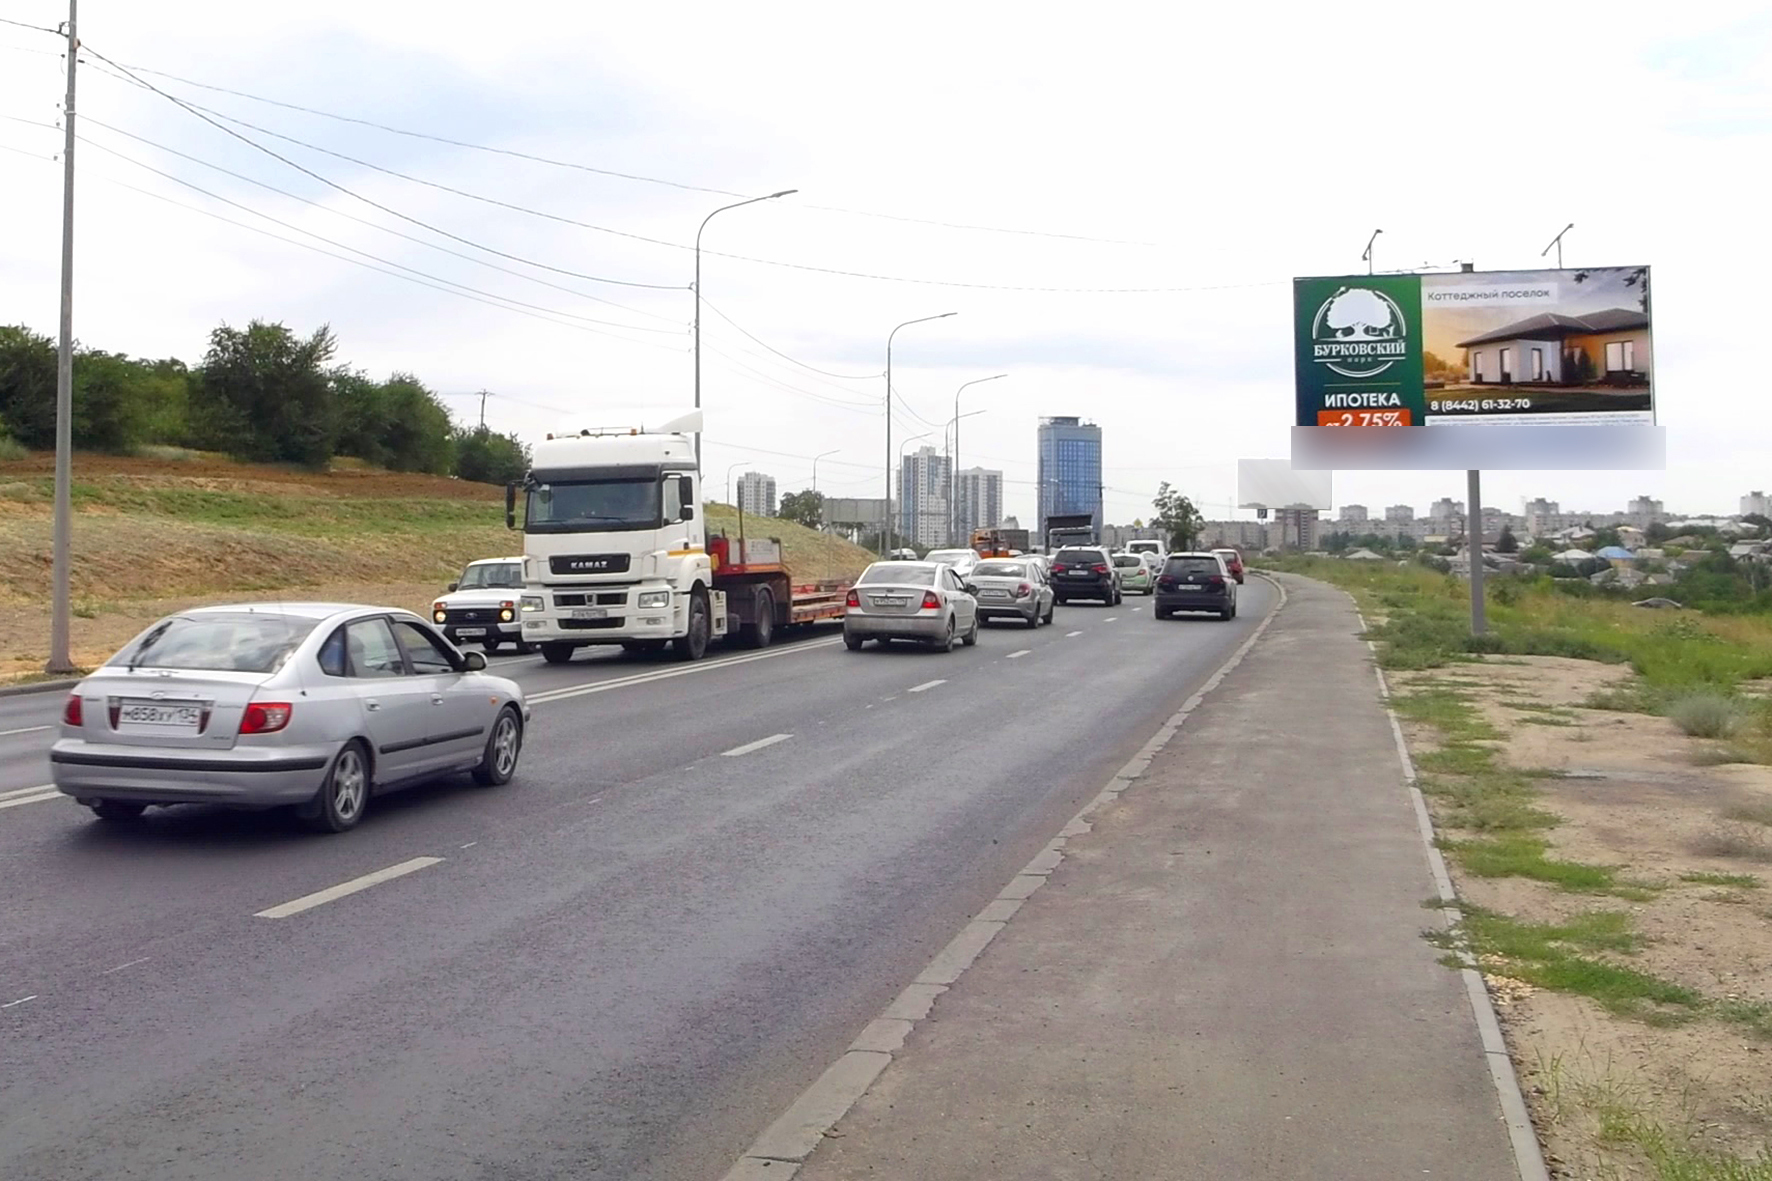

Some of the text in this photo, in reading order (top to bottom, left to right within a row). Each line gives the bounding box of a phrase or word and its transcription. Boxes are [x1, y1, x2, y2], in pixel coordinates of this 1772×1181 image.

[1427, 289, 1550, 301] Коттеджный поселок
[1313, 339, 1406, 356] БУРКОВСКИЙ
[1324, 392, 1401, 407] ИПОТЕКА
[1430, 399, 1531, 412] 8 (8442) 61-32-70
[570, 560, 608, 569] KAMAZ
